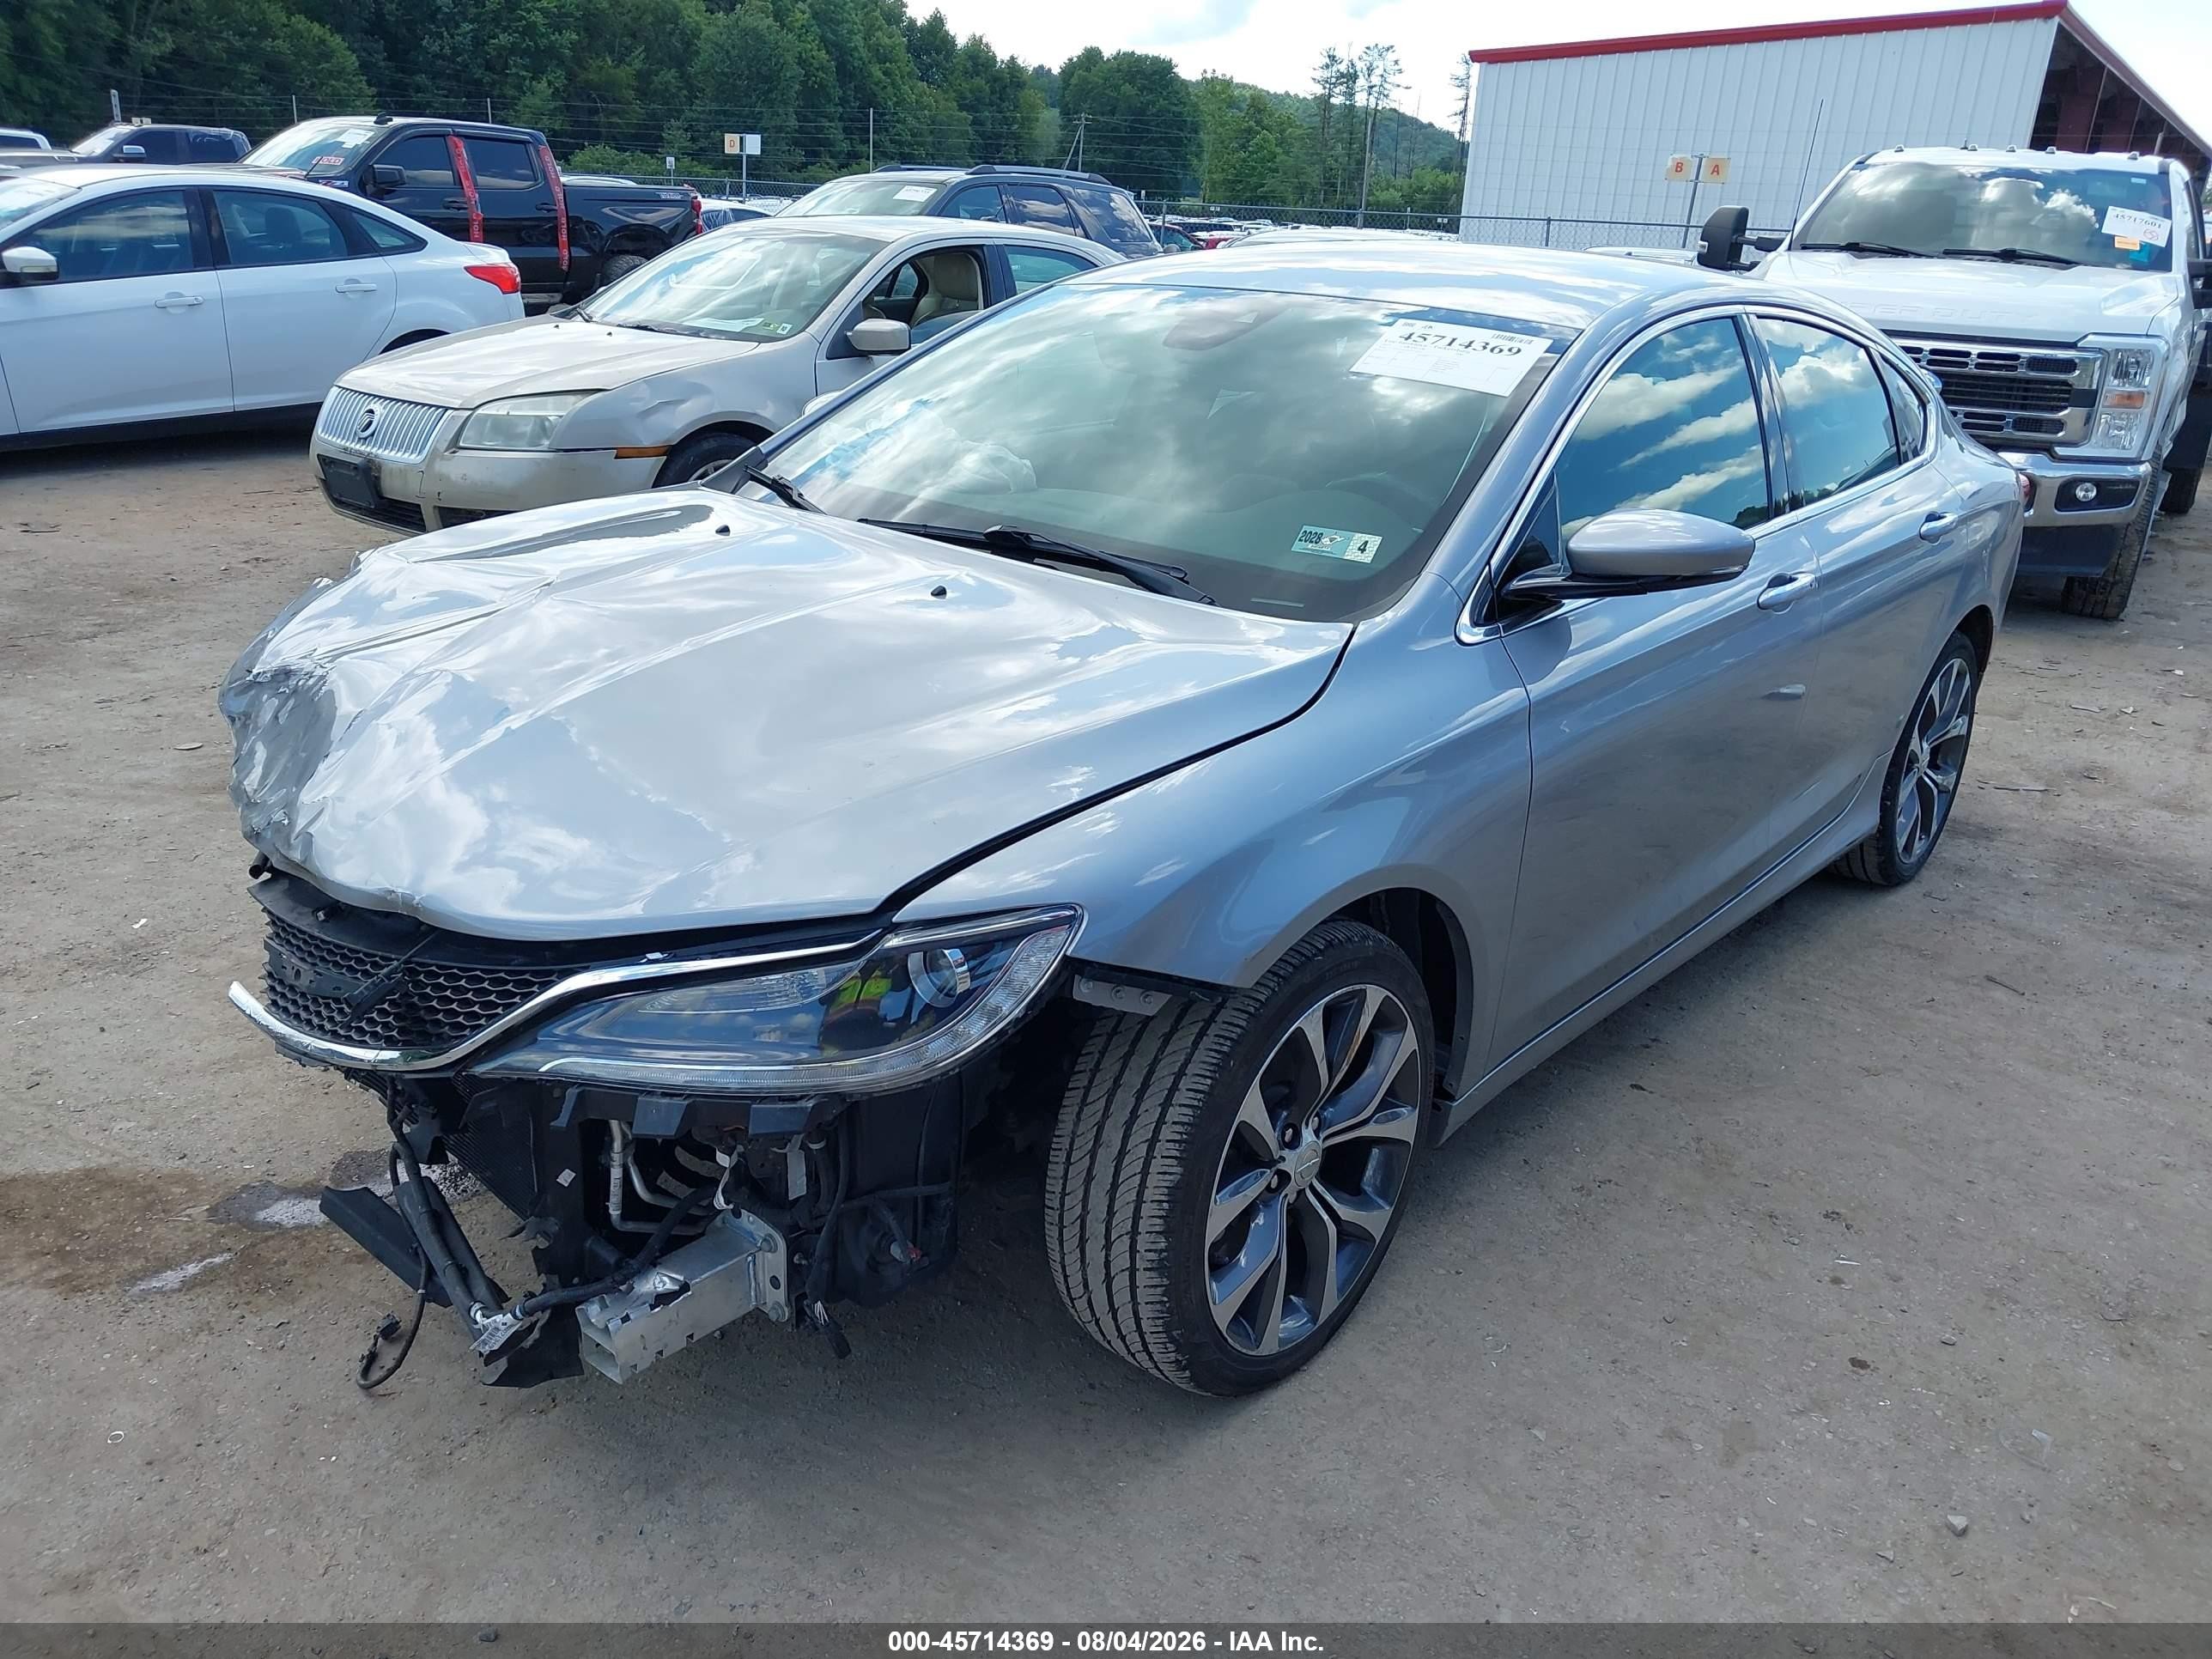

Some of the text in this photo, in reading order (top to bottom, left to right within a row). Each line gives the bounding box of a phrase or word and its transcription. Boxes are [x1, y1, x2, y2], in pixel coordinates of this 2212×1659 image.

[729, 139, 735, 148] D
[544, 155, 556, 178] HOLD
[1674, 161, 1684, 173] B
[1710, 164, 1719, 175] A
[1399, 331, 1522, 356] 45714369
[1297, 530, 1324, 544] 2028
[1357, 540, 1370, 554] 4
